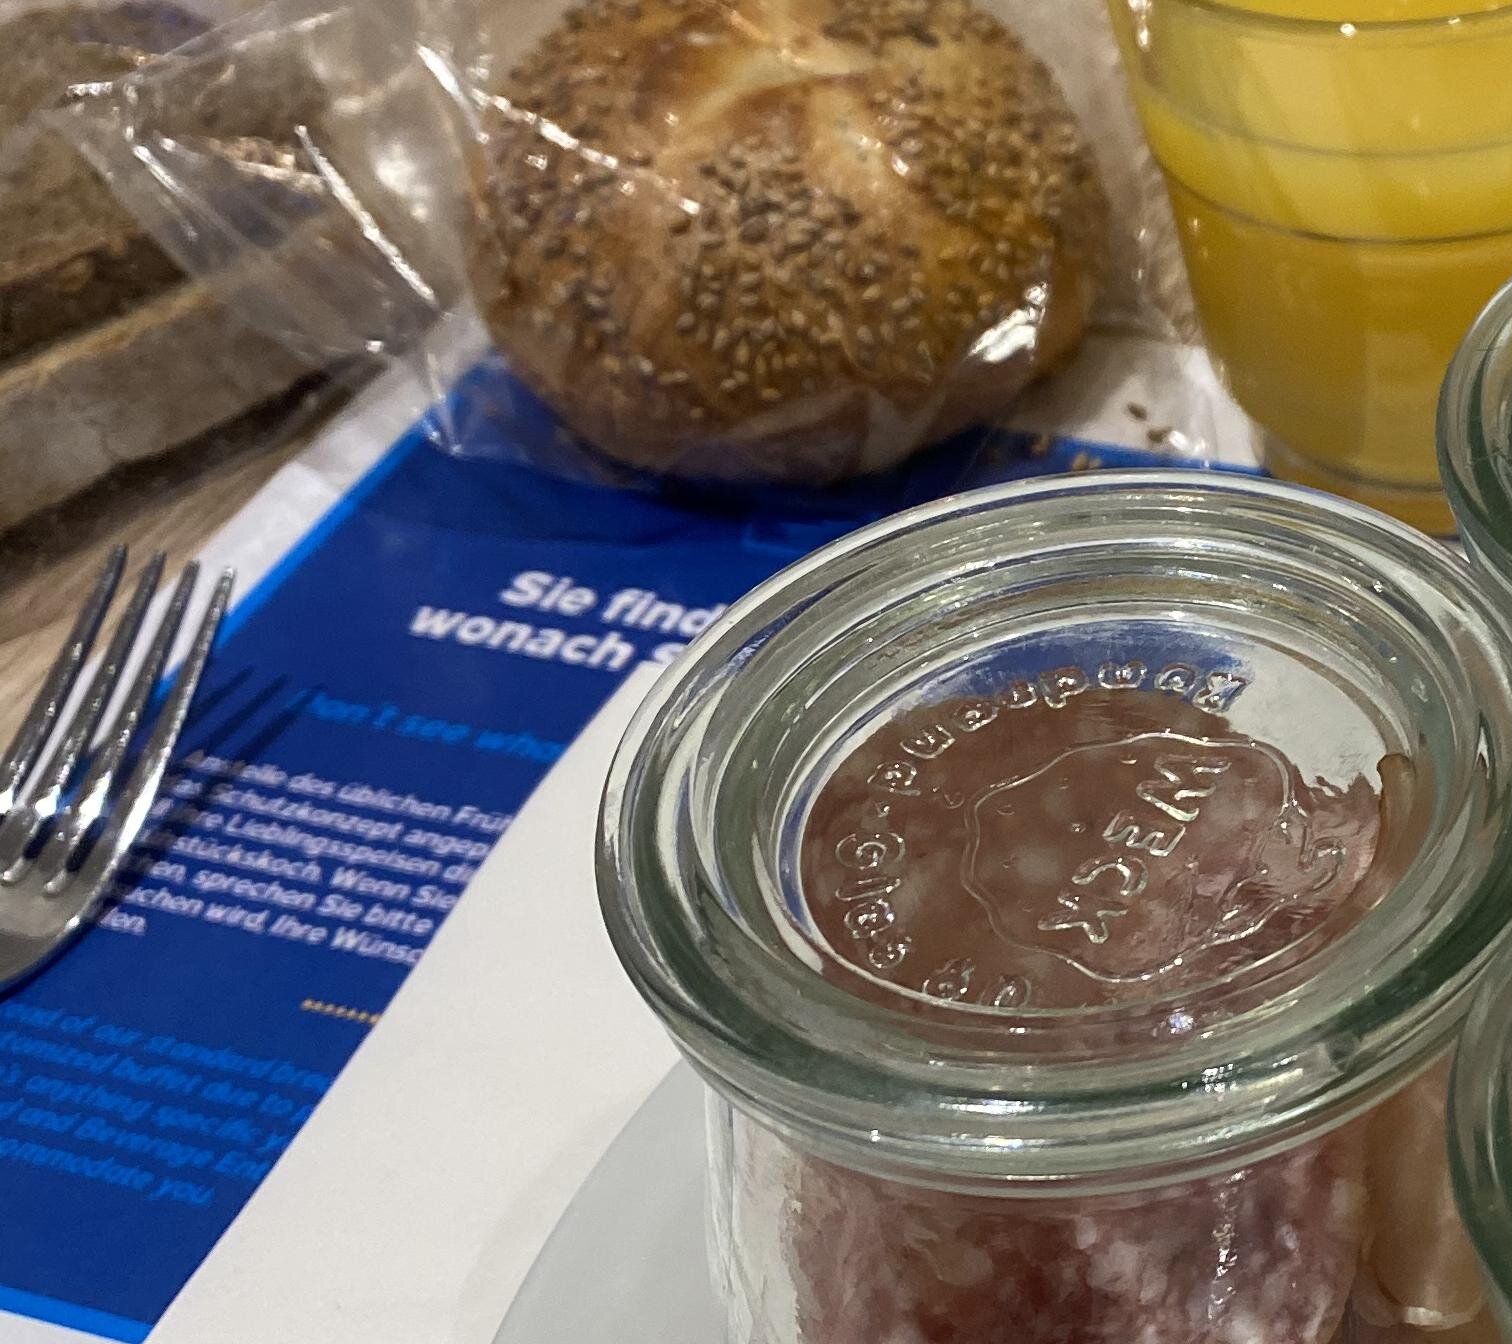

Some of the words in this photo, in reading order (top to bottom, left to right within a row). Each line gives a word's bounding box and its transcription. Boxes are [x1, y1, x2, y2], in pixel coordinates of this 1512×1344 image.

[501, 570, 598, 619] Sie
[409, 606, 635, 672] wonach
[288, 773, 337, 800] des
[337, 783, 451, 822] üblichen
[225, 814, 441, 878] Lieblingsspeisen
[1036, 751, 1233, 944] WECK
[191, 870, 318, 911] sprechen
[315, 894, 364, 922] Sie
[361, 903, 435, 937] bitte
[330, 866, 412, 902] Wenn
[267, 915, 329, 946] Ihre
